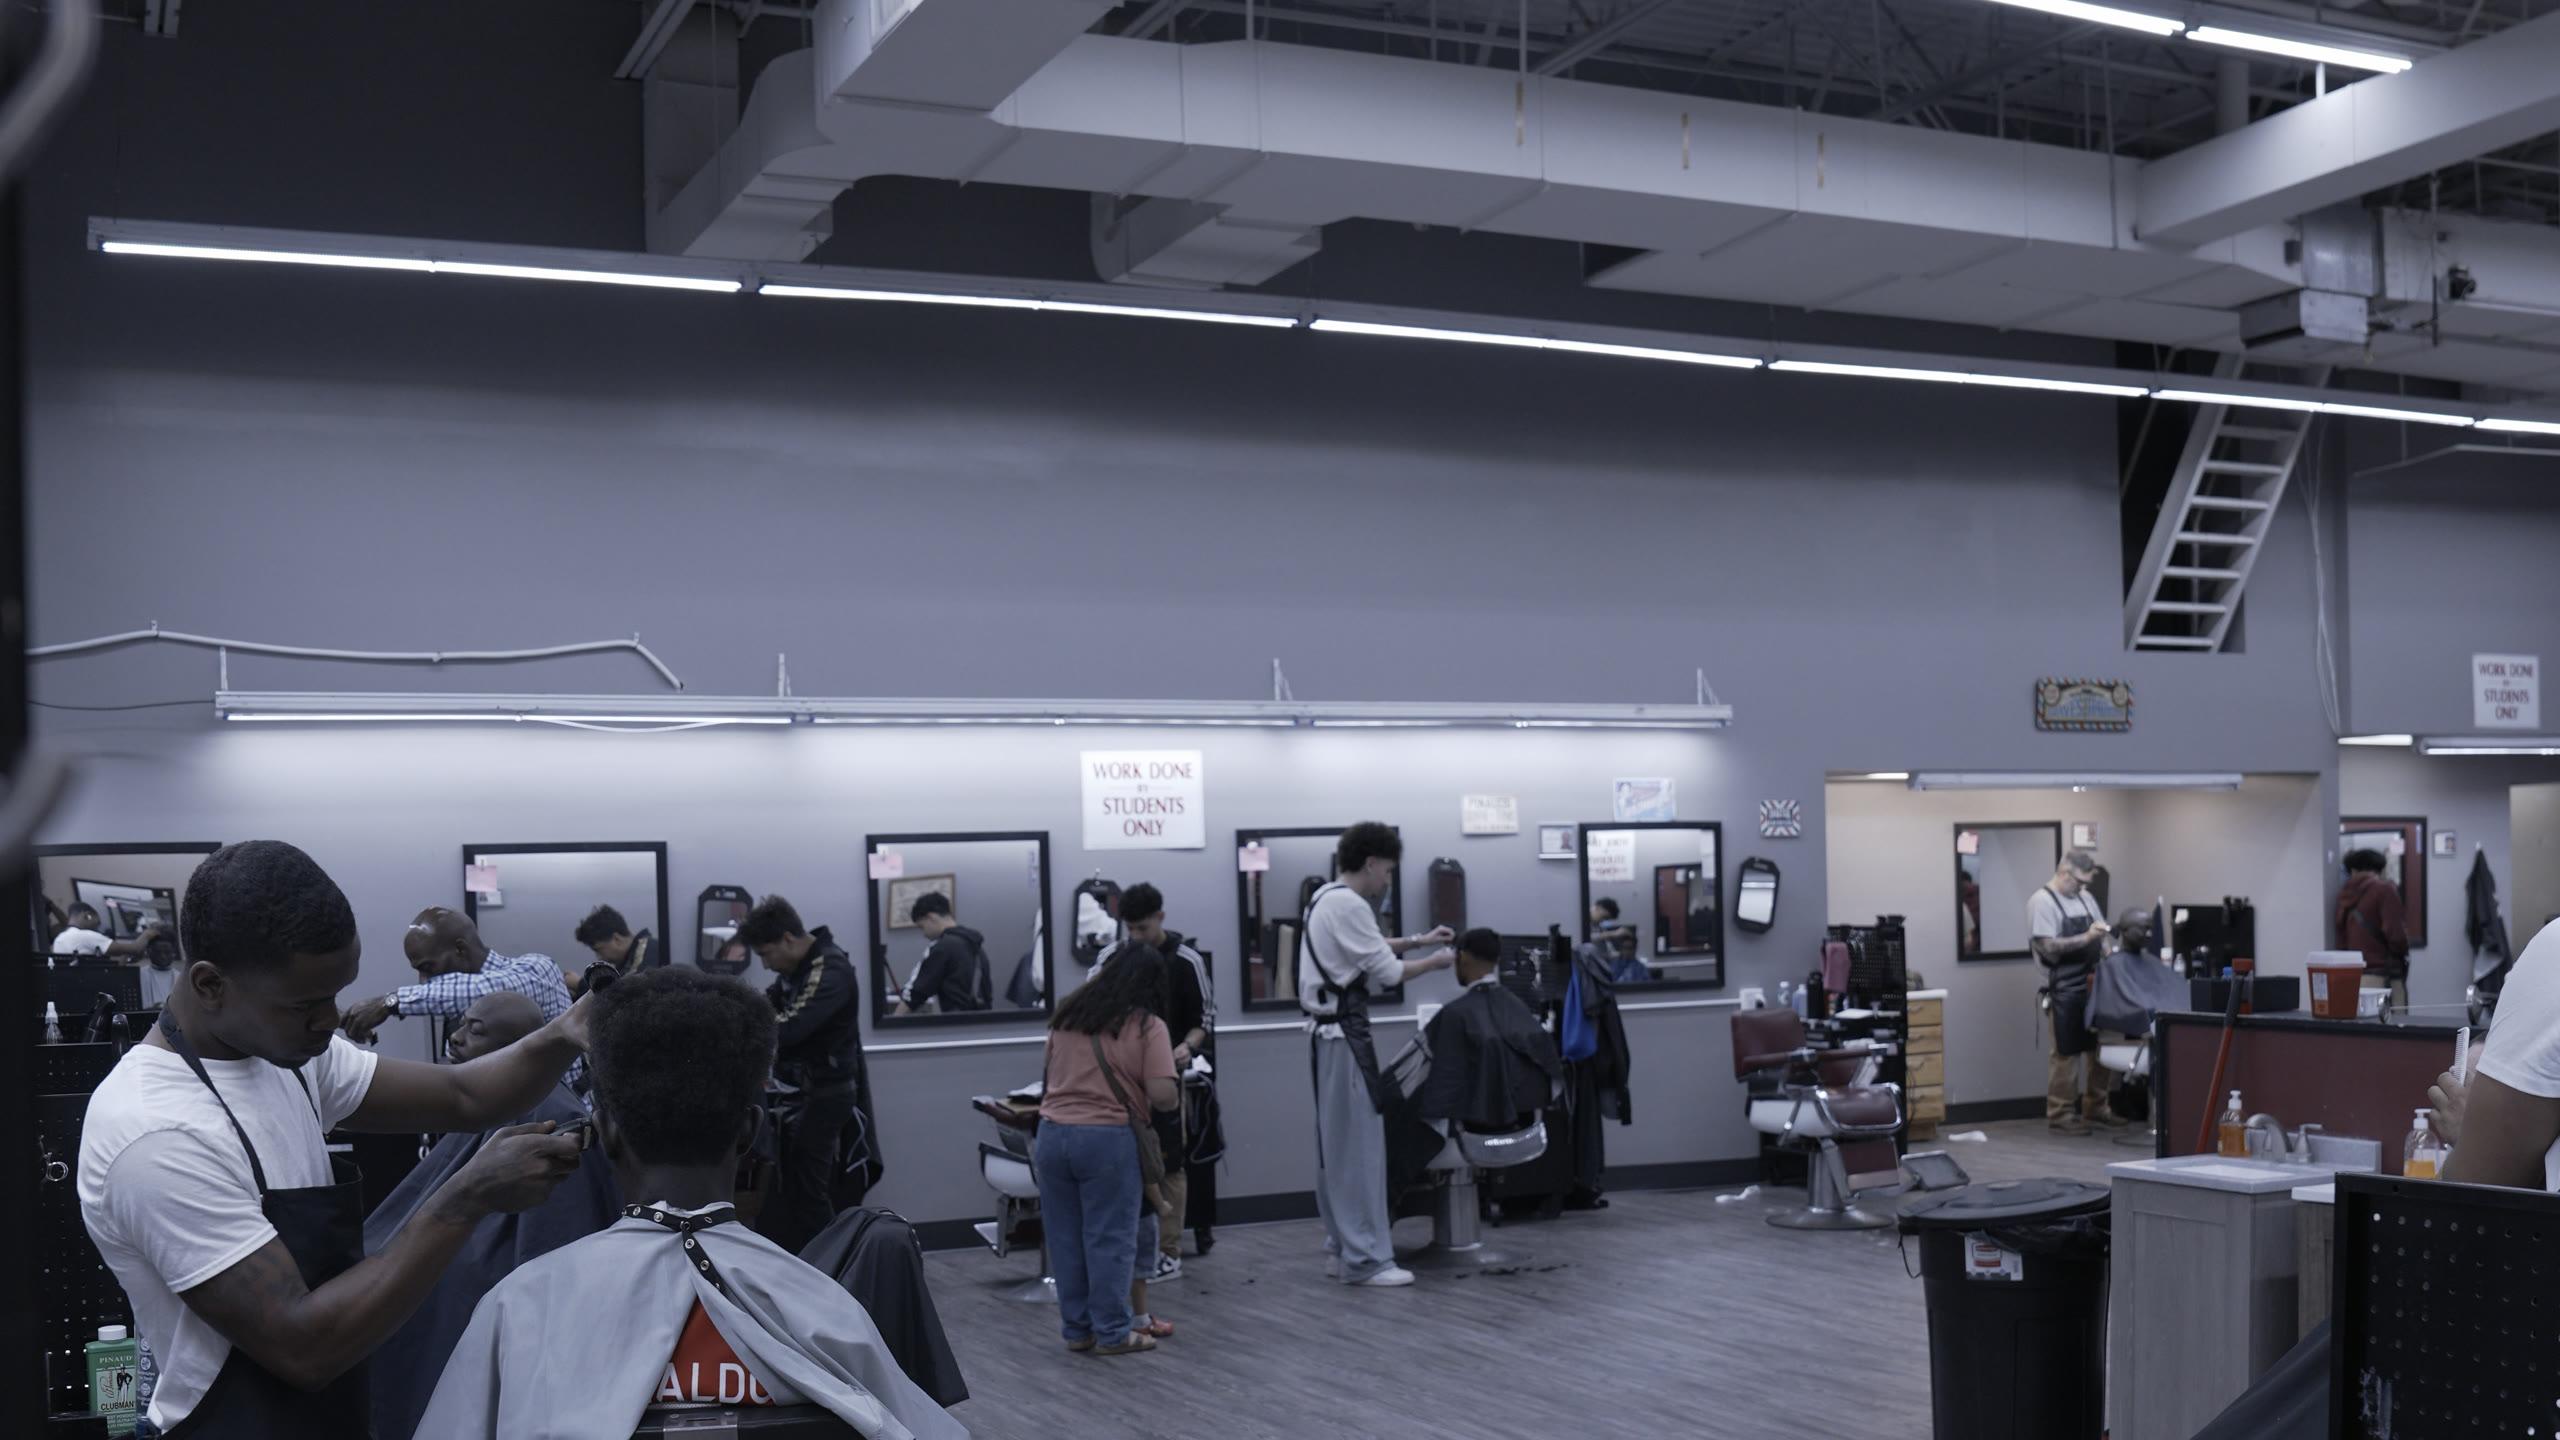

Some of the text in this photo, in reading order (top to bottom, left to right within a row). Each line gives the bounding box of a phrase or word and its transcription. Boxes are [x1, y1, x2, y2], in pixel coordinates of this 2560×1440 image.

[2479, 663, 2533, 678] WORK DONE
[2484, 689, 2529, 703] STUDENTS
[2495, 706, 2518, 719] ONLY
[1093, 762, 1193, 779] WORK DONE
[1103, 797, 1185, 815] STUDENTS
[1123, 819, 1164, 837] ONLY
[101, 1401, 134, 1411] CLUBMAN
